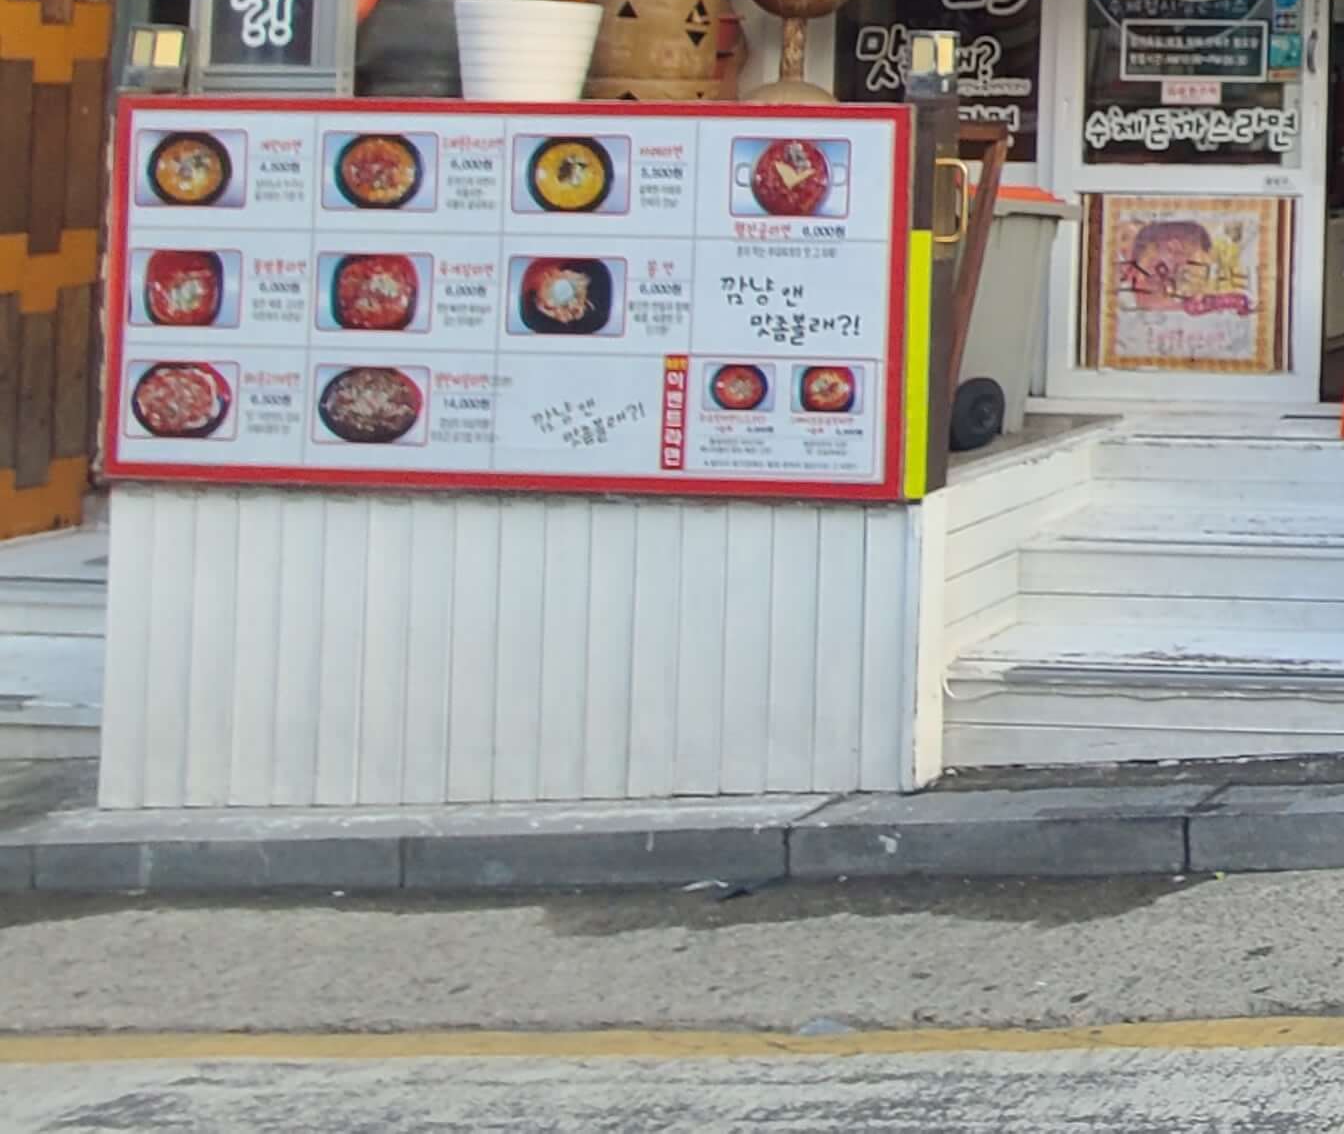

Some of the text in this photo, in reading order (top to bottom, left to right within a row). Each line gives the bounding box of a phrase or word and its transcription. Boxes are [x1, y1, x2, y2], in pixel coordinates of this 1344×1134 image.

[1085, 105, 1297, 152] 수제돈까스라면
[719, 276, 775, 307] 깜냥
[750, 312, 861, 346] 맛좀볼래?!
